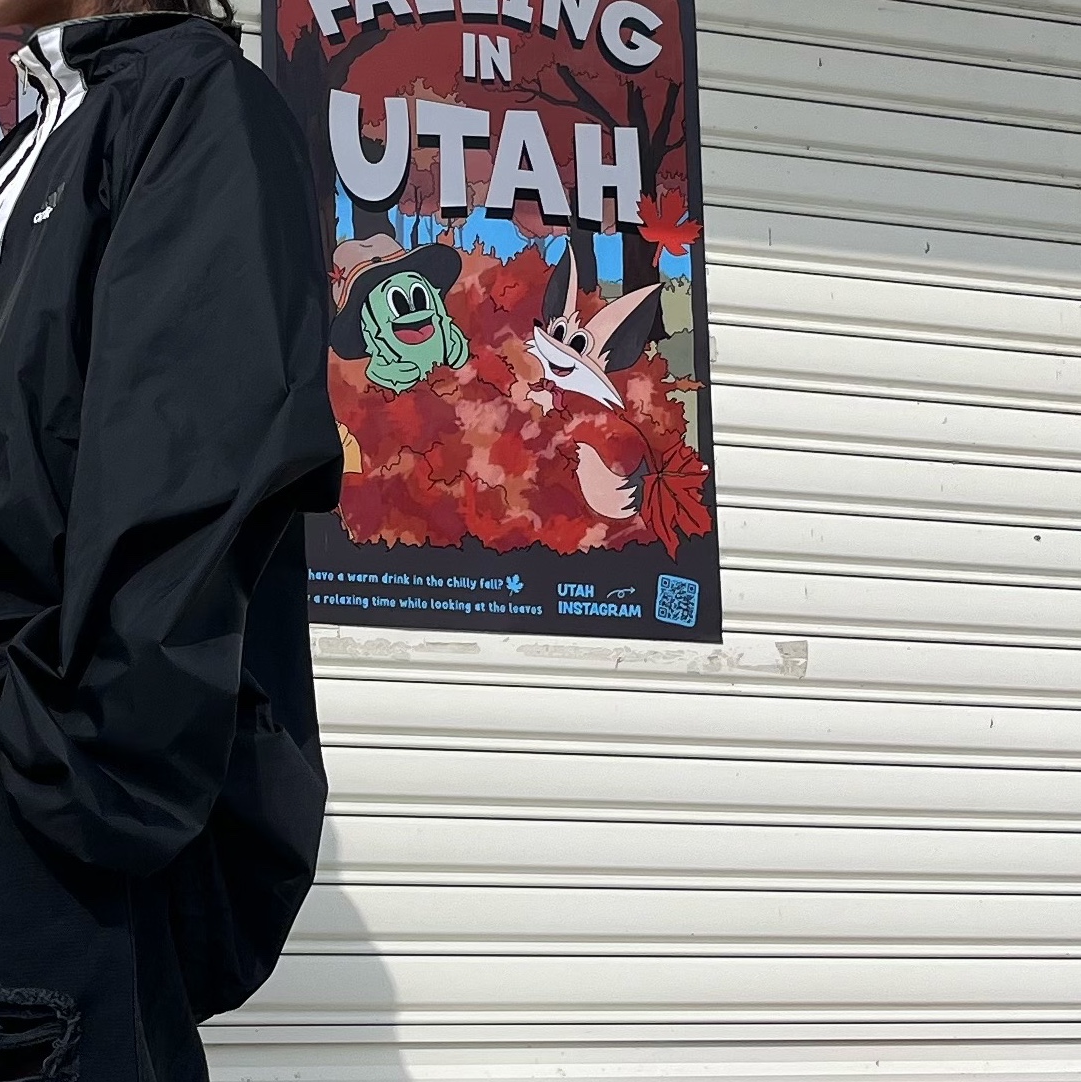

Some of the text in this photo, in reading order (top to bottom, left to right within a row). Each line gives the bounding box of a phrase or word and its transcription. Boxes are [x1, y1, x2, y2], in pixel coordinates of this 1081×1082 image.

[462, 33, 512, 82] IN
[329, 89, 645, 224] UTAH
[337, 572, 345, 582] a
[347, 573, 379, 583] warm
[381, 573, 410, 585] drink
[413, 574, 424, 586] in
[425, 575, 444, 587] the
[446, 576, 477, 591] chilly
[479, 578, 504, 590] fall?
[557, 583, 595, 598] UTAH
[313, 594, 321, 604] a
[323, 593, 369, 609] relaxing
[371, 596, 396, 608] time
[399, 596, 428, 609] while
[430, 598, 472, 614] looking
[474, 602, 486, 612] at
[488, 601, 506, 614] the
[508, 602, 543, 615] leaves
[558, 601, 642, 618] INSTAGRAM
